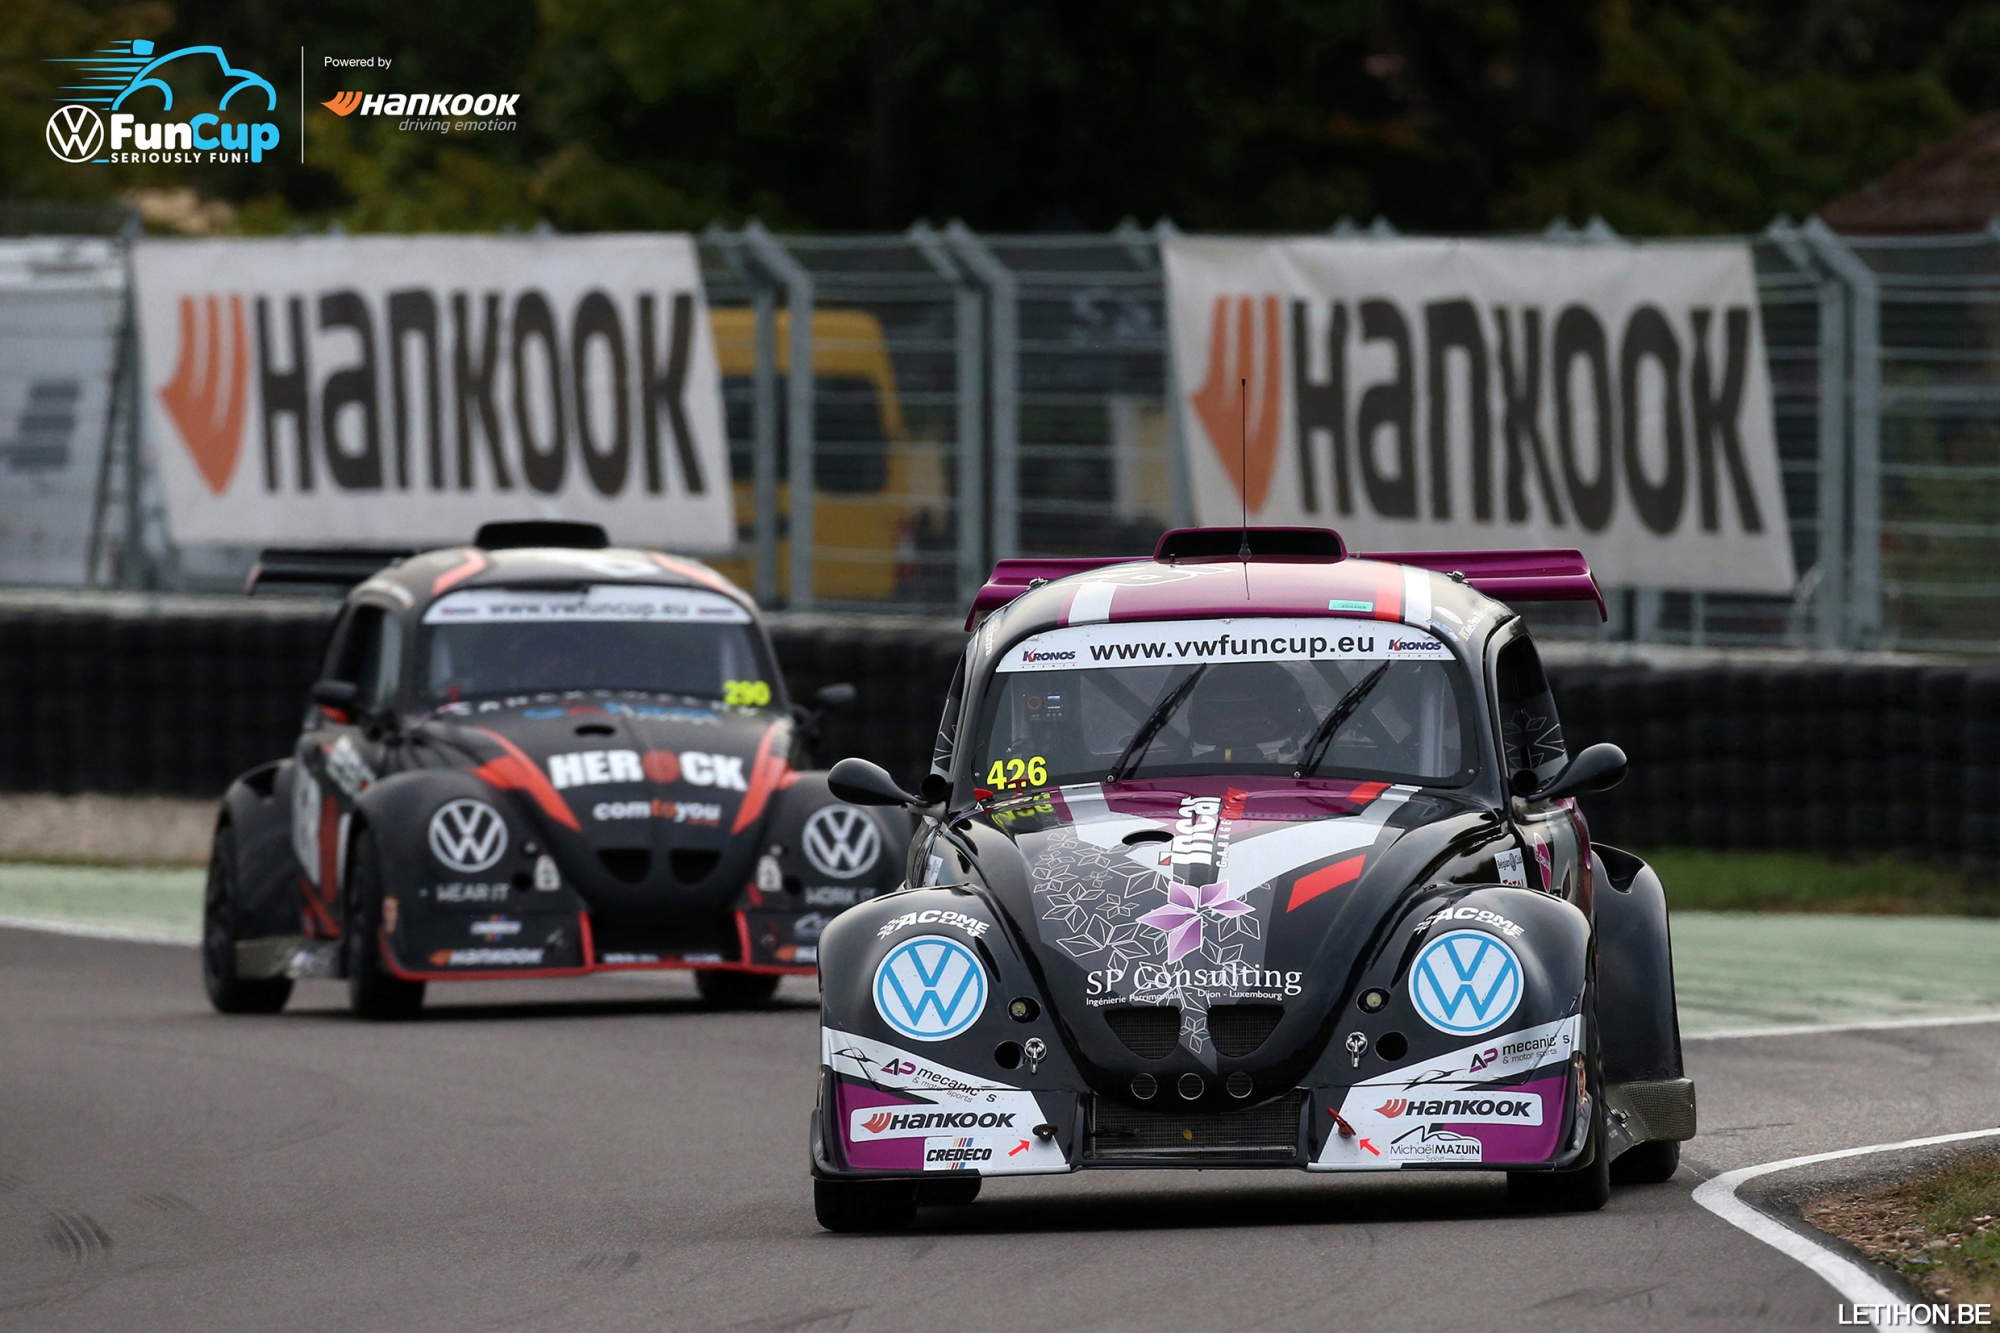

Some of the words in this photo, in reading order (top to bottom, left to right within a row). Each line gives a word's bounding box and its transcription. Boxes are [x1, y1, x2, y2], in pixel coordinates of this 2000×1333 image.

[1090, 633, 1375, 662] www.vwfuncup.eu
[1388, 636, 1442, 652] KRONOS
[1022, 647, 1076, 663] KRONOS
[986, 755, 1048, 790] 426
[593, 797, 722, 824] comtoyou
[1215, 816, 1233, 869] GARAGE
[895, 909, 991, 936] ACOME
[1430, 906, 1525, 937] ACOME
[1086, 969, 1124, 996] SP
[1134, 962, 1303, 996] Consulting
[1229, 990, 1283, 1000] Luxembourg
[1511, 1052, 1534, 1063] motor
[1536, 1048, 1557, 1058] sports
[946, 1089, 974, 1103] sports
[926, 1147, 993, 1162] CREDECO
[1425, 1154, 1445, 1163] Sport
